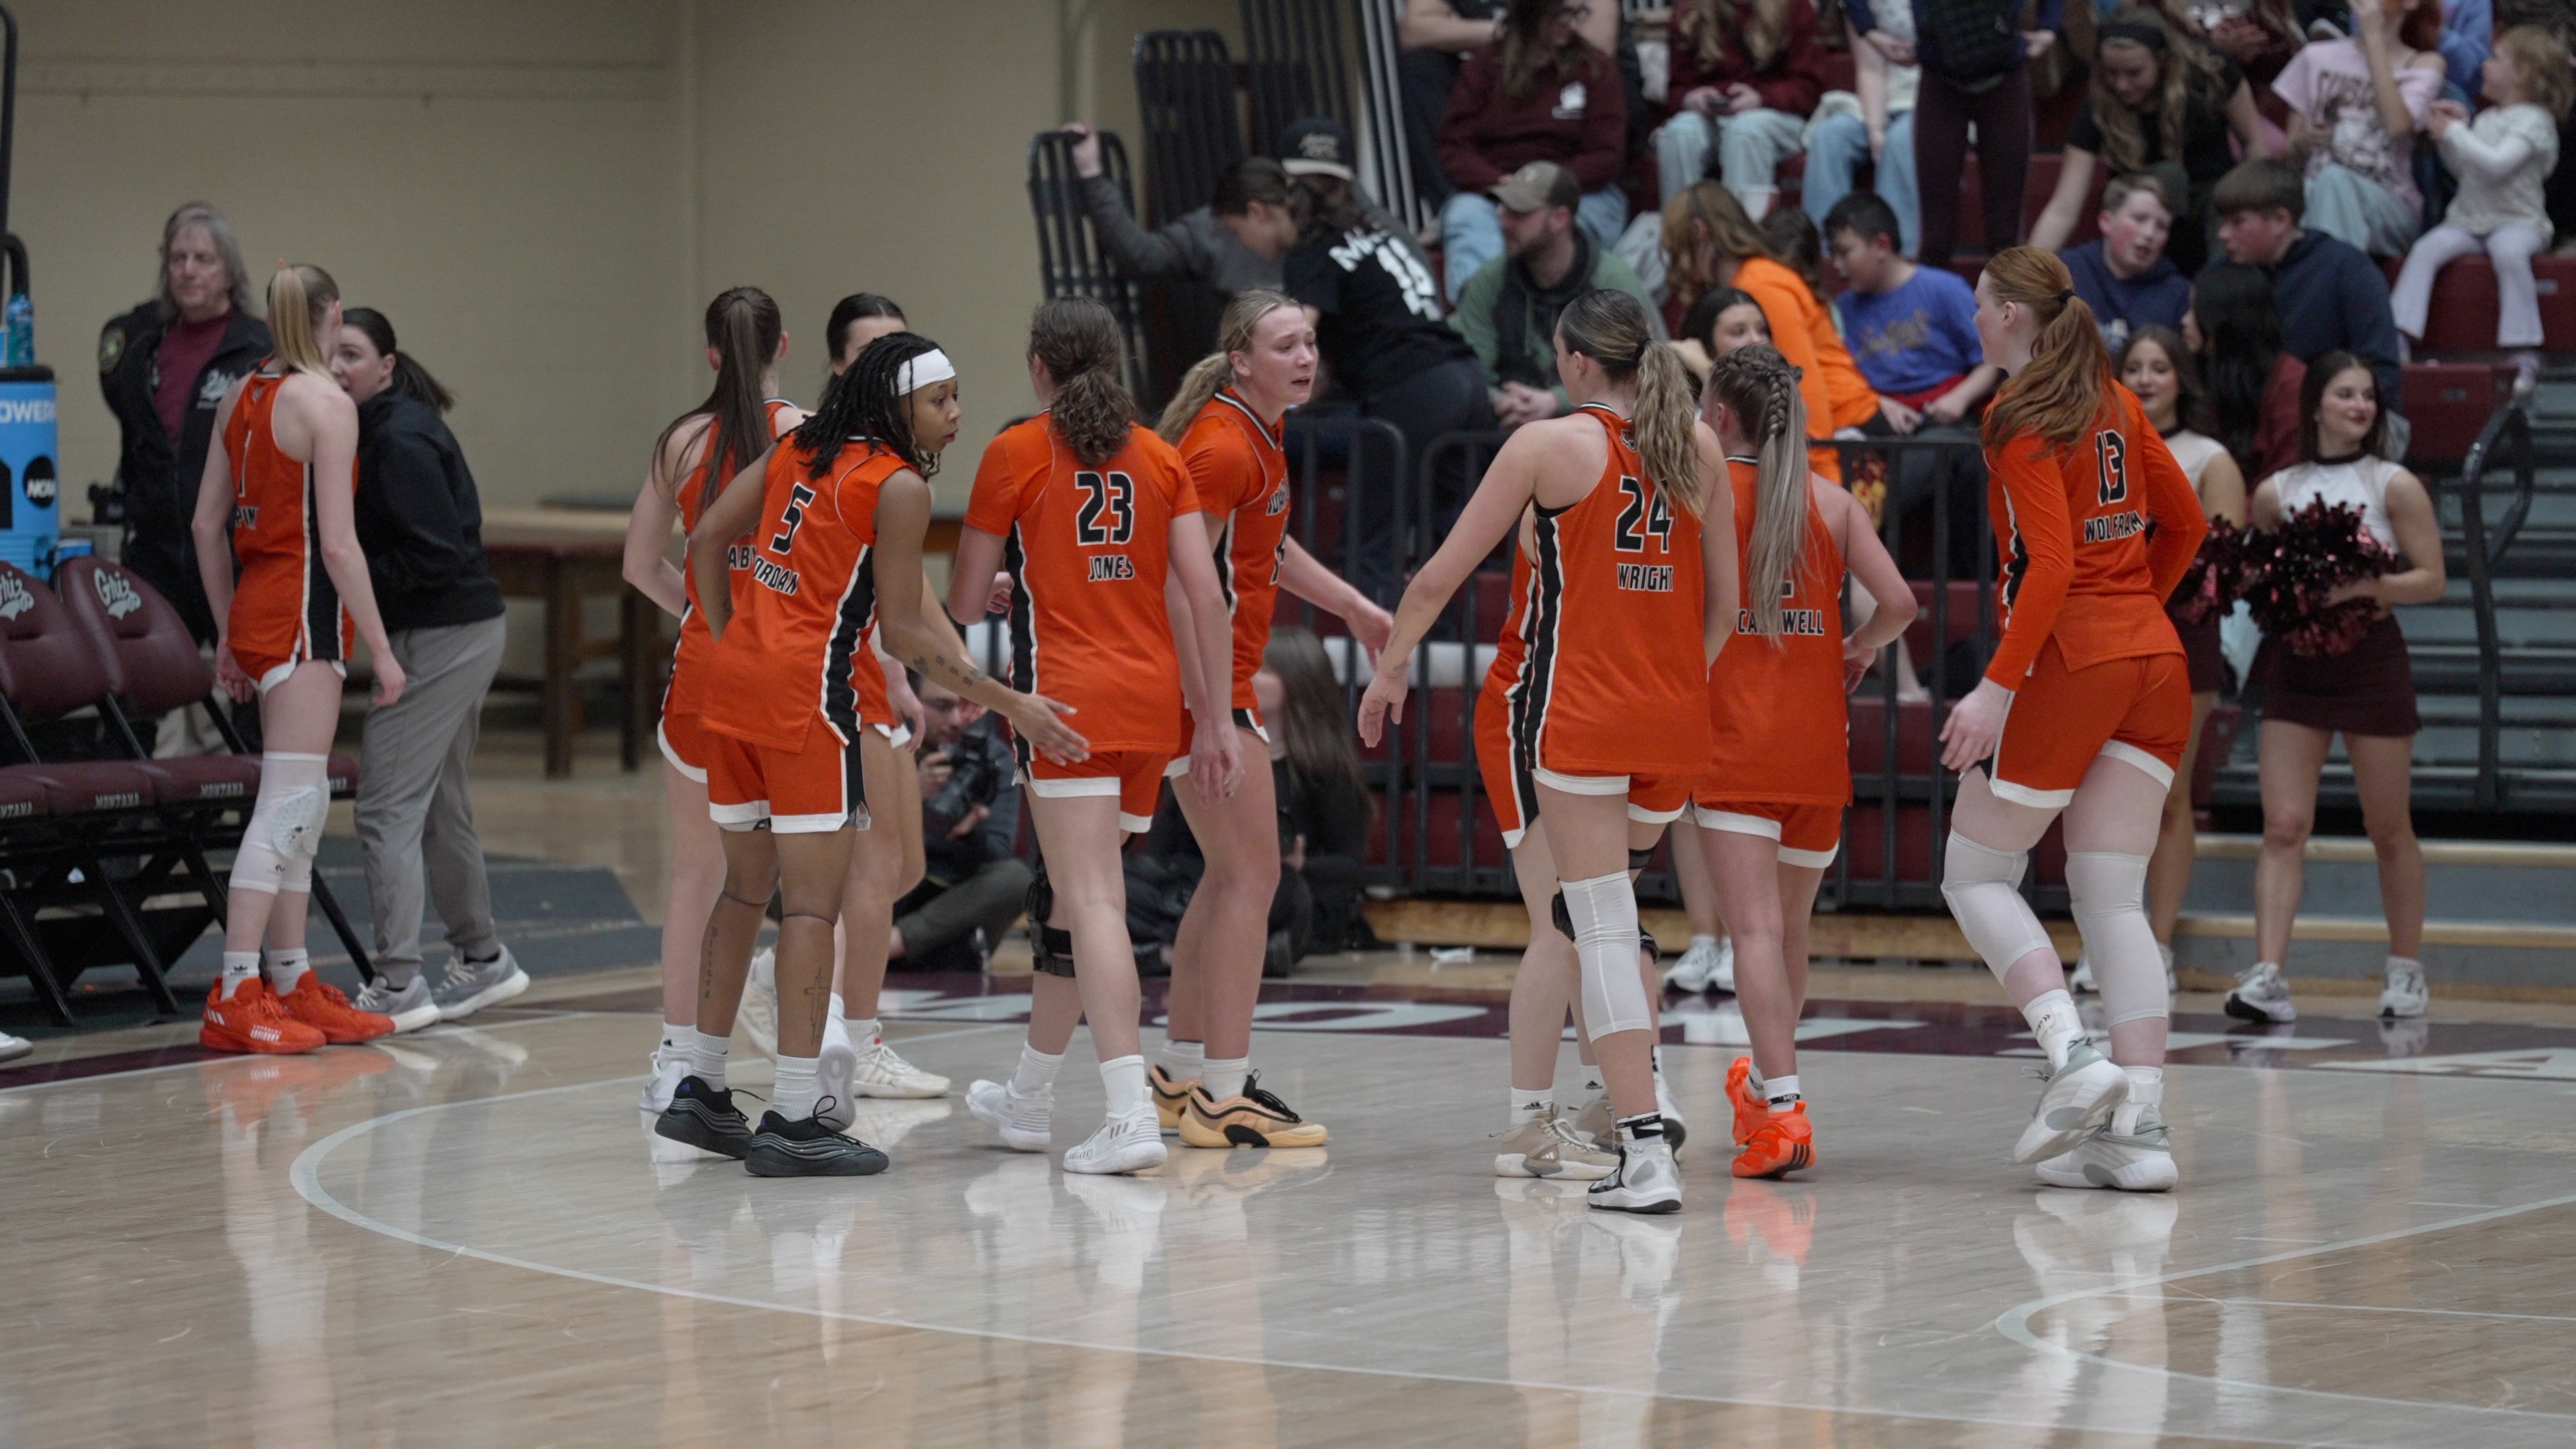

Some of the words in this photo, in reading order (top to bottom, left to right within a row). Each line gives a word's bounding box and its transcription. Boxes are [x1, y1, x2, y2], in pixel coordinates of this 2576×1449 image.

[2095, 429, 2127, 507] 13
[768, 482, 816, 555] 5
[1074, 471, 1134, 546] 23
[1614, 474, 1674, 554] 24
[2084, 511, 2145, 543] WOLFRAM
[753, 555, 800, 596] ORDAN
[1087, 554, 1134, 582] JONES
[1617, 562, 1673, 592] WRIGHT
[1736, 608, 1825, 636] CAWELL
